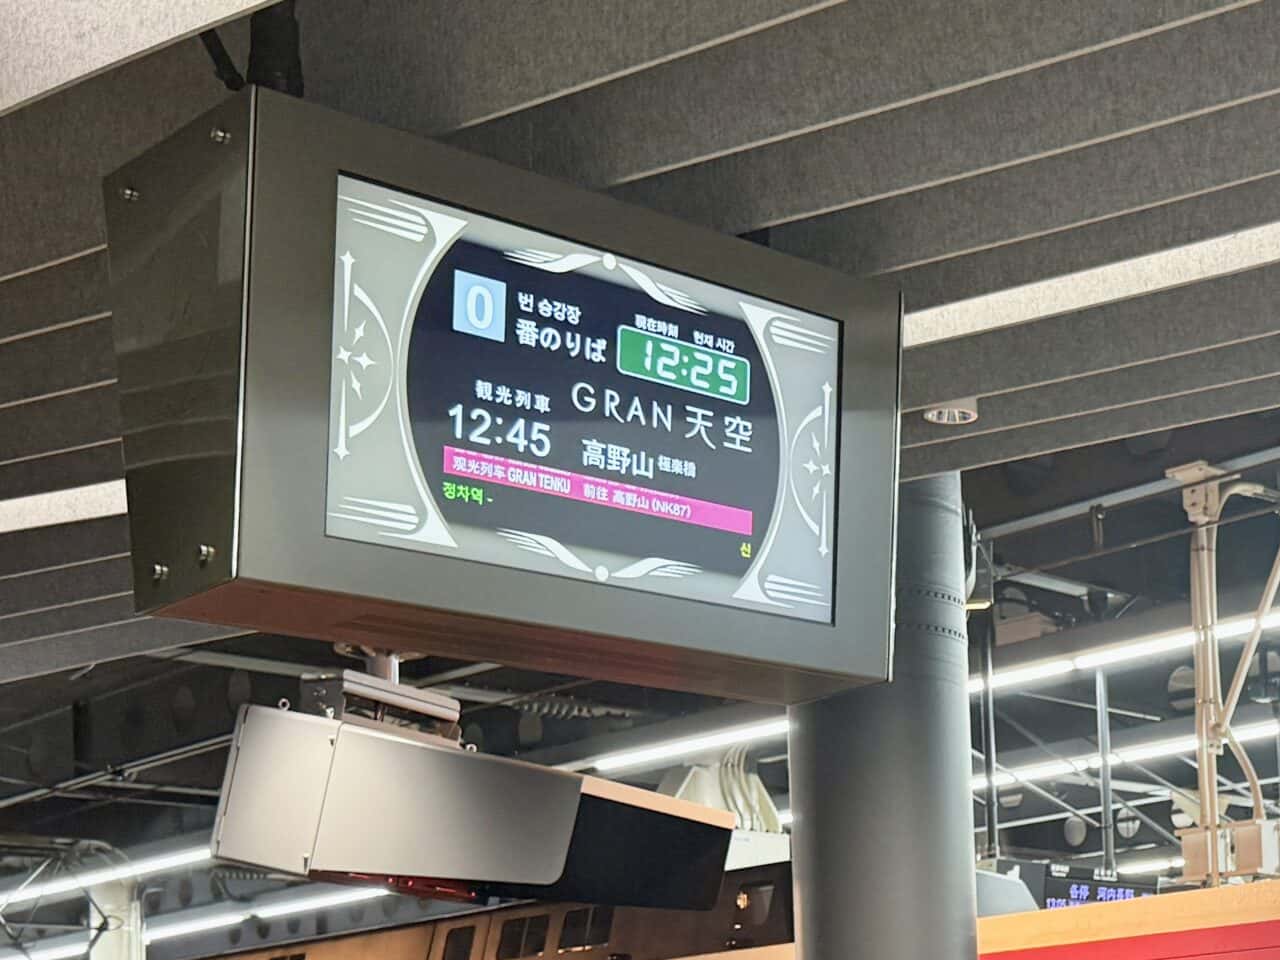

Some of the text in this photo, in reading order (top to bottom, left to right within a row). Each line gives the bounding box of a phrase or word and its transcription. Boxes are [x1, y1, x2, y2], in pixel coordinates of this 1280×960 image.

[466, 285, 494, 329] 0
[517, 291, 582, 325] 번 승강장
[634, 313, 679, 339] 現在時刻
[515, 318, 607, 362] 番のりば
[693, 330, 735, 354] 현재 시간
[644, 339, 739, 396] 12:25
[475, 380, 551, 413] 観光列車
[448, 404, 551, 457] 12:45
[582, 438, 655, 479] 高野山
[442, 482, 484, 505] 정차역
[507, 468, 537, 487] GRAN
[539, 473, 571, 494] TENKU
[651, 500, 693, 518] (NK87)
